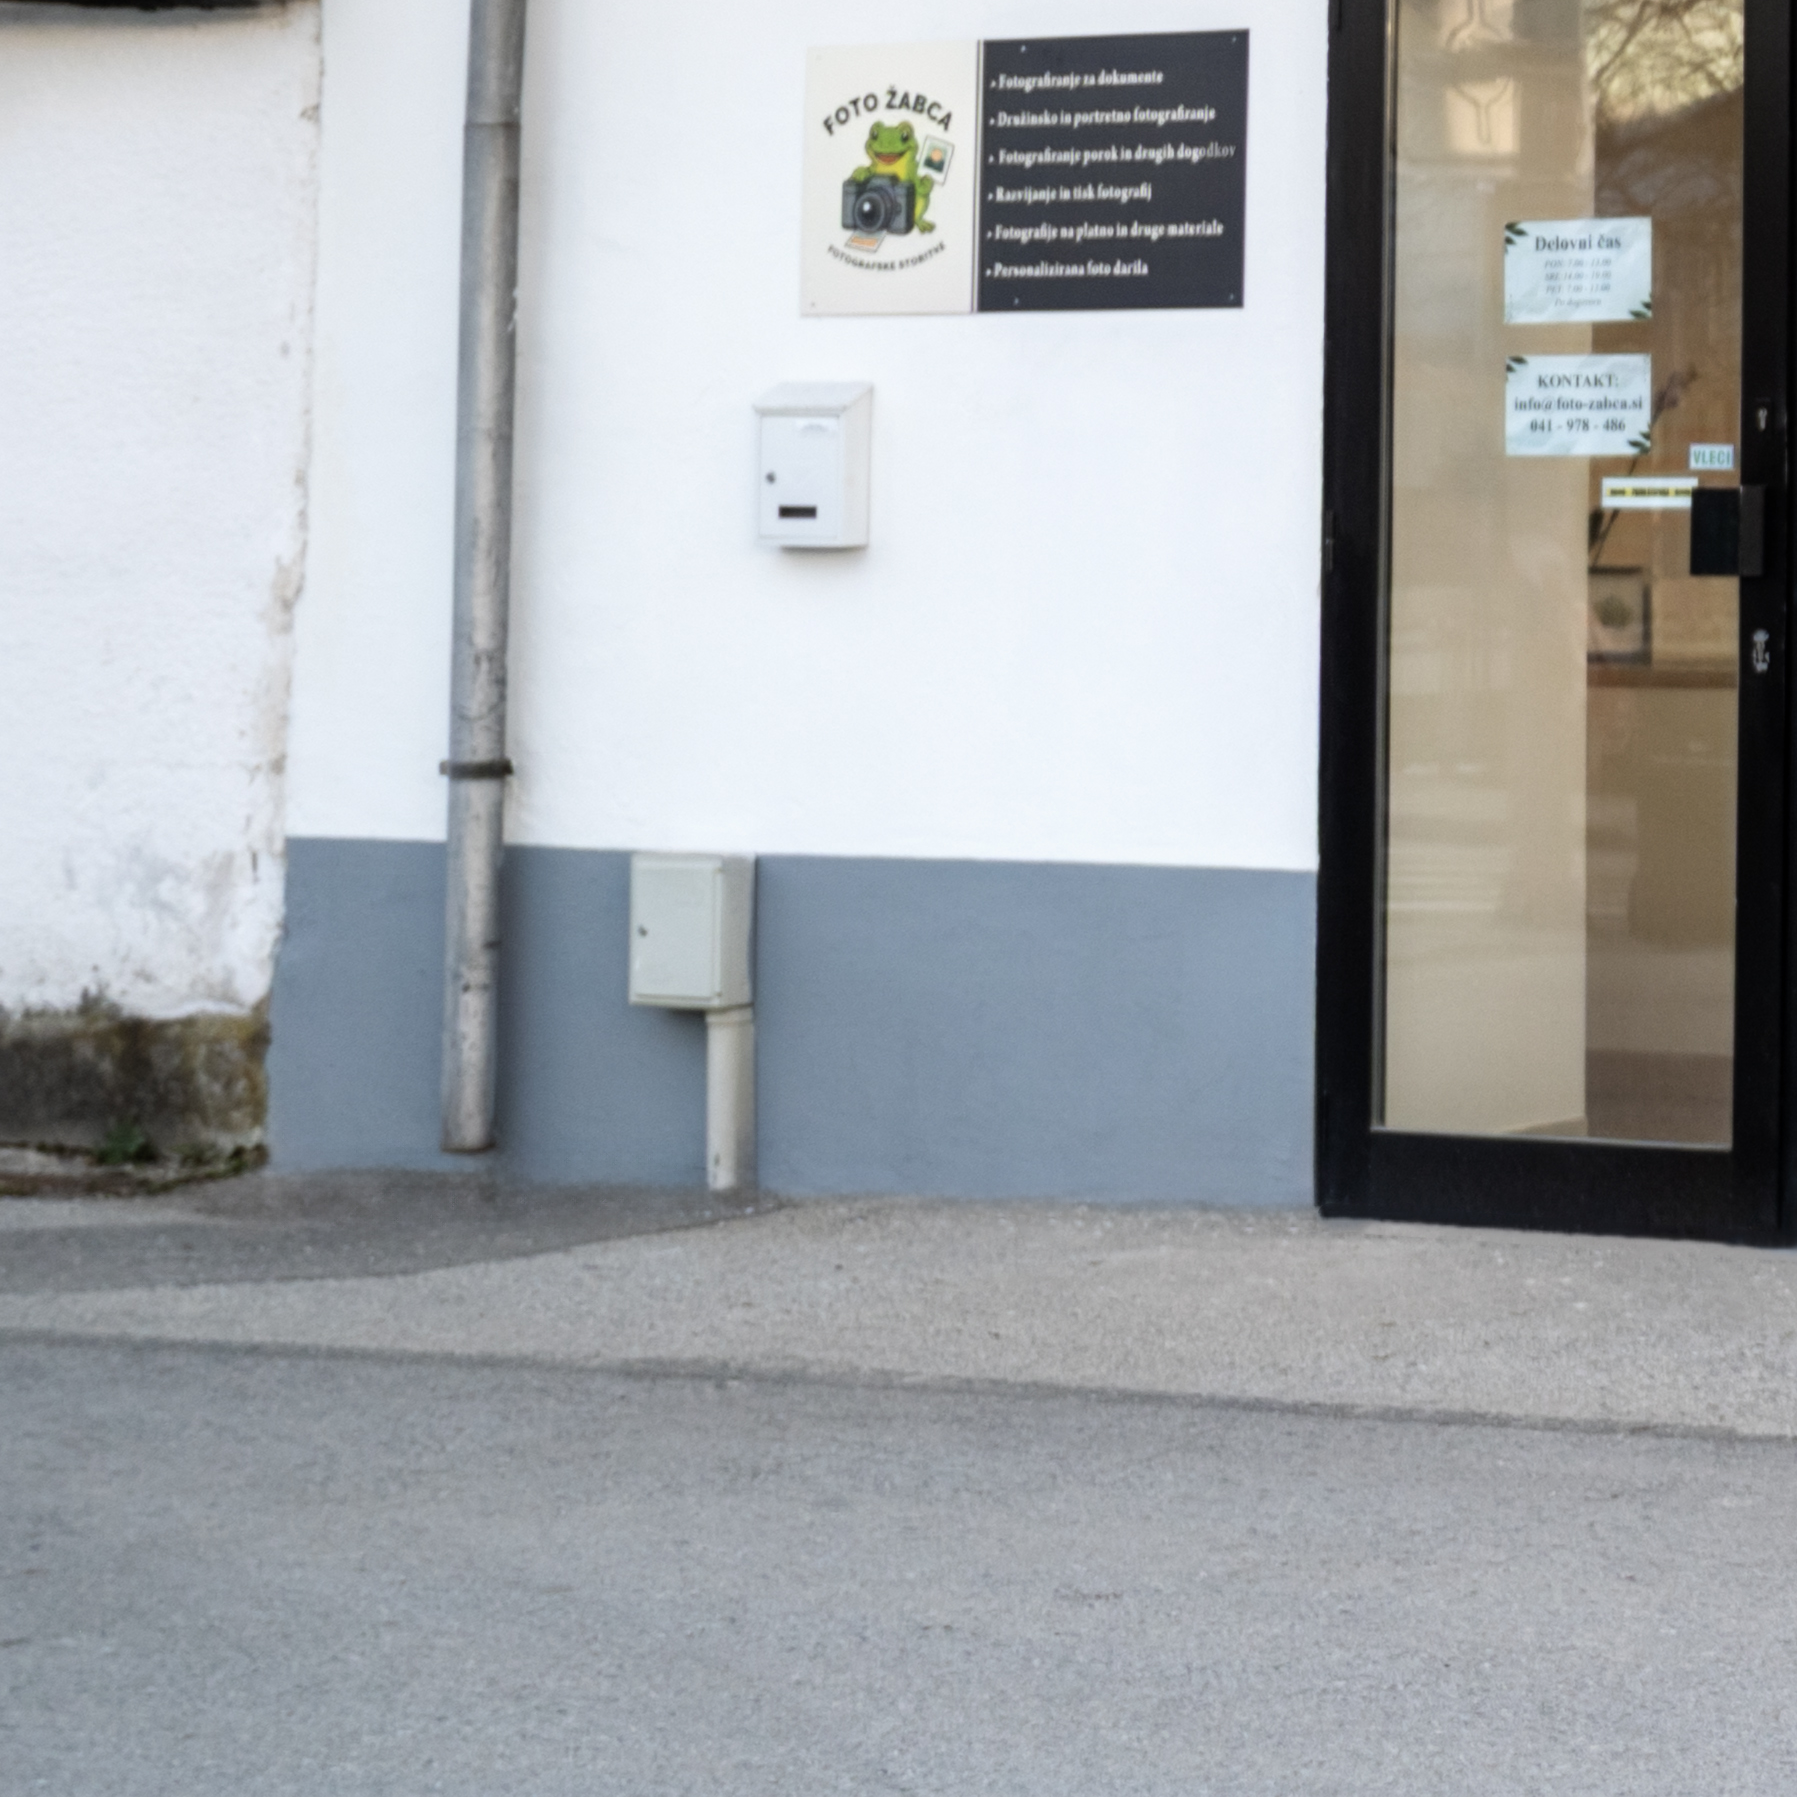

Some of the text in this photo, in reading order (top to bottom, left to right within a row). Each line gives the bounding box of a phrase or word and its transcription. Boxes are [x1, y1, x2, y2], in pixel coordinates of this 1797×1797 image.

[999, 68, 1164, 93] Fotografiranje za dokumente
[823, 84, 953, 137] FOTO ŽABCA
[997, 104, 1216, 129] Družinsko in portretno fotografiranje
[999, 141, 1237, 169] Fotografiranje porok in drugih dogodkov
[996, 182, 1152, 205] Razvijanje in tisk fotografij
[995, 218, 1224, 245] Fotografije na platno in druge materiale
[1535, 233, 1622, 251] Delovni čas
[827, 243, 896, 271] FOTOGRAFSKE
[993, 257, 1148, 278] Personalizirana foto darila
[1538, 373, 1619, 388] KONTAKT:
[1514, 395, 1643, 412] info@foto-zabca.si
[1530, 418, 1552, 432] 041
[1567, 418, 1590, 432] 978
[1603, 417, 1625, 432] 486
[1693, 450, 1731, 464] VLECI
